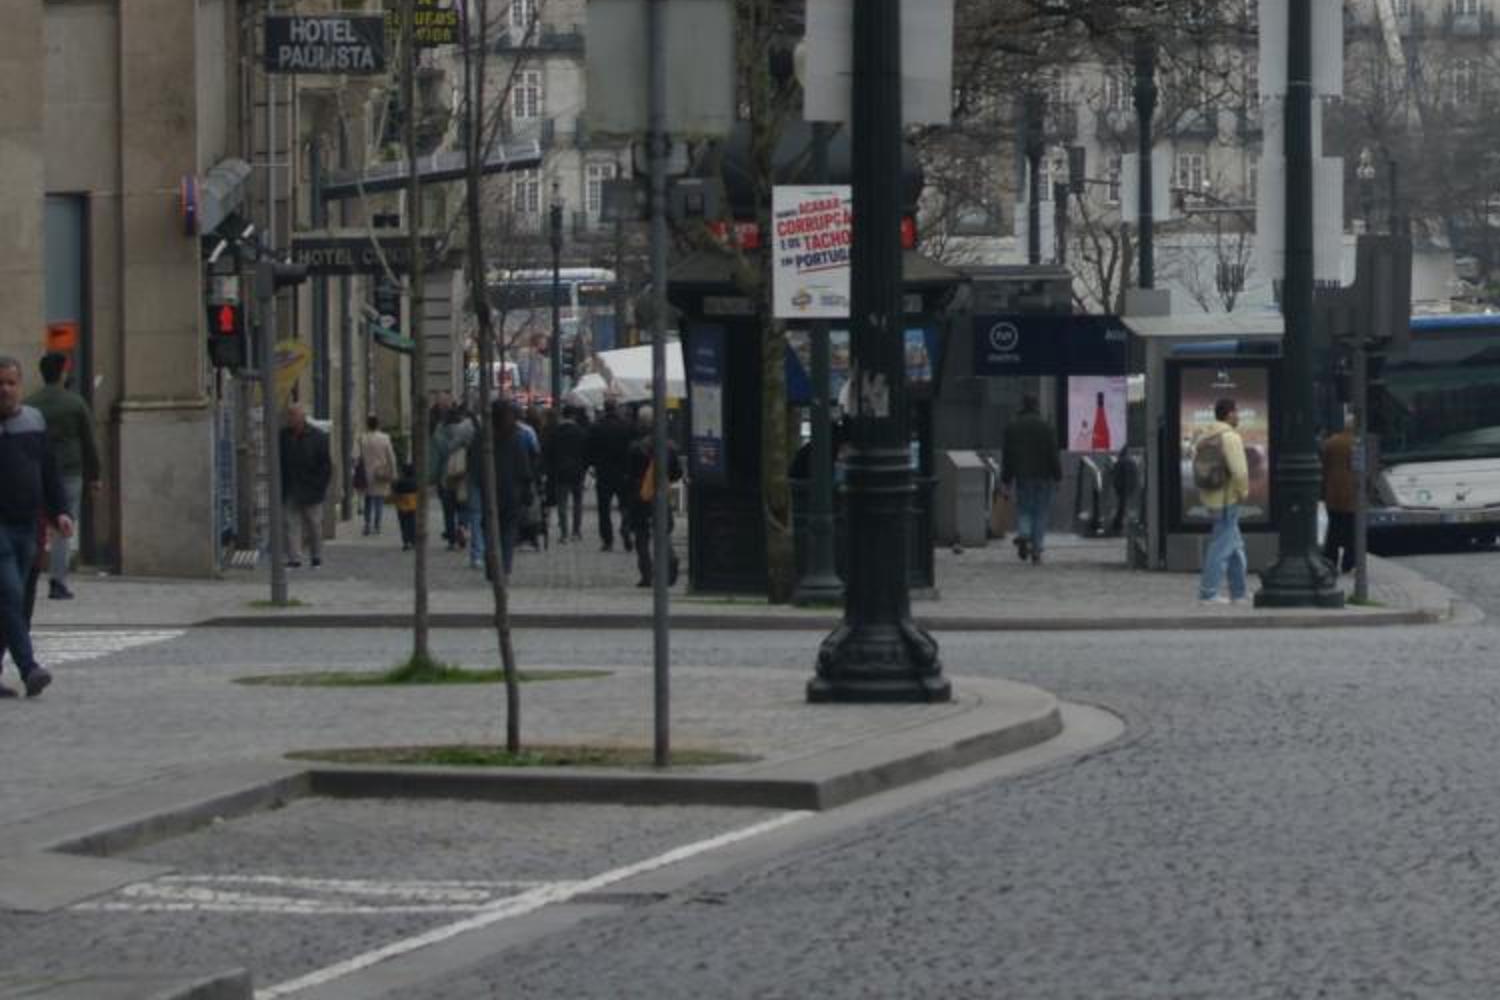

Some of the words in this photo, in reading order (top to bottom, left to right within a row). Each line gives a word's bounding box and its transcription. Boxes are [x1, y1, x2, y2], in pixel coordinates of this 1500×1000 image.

[289, 18, 357, 42] HOTEL
[278, 45, 375, 70] PAULISTA
[799, 197, 840, 214] ACABAR
[776, 209, 854, 237] CORRUPÇÃ
[803, 229, 853, 251] TACHO
[298, 249, 353, 265] HOTEL
[795, 249, 850, 268] PORTUG
